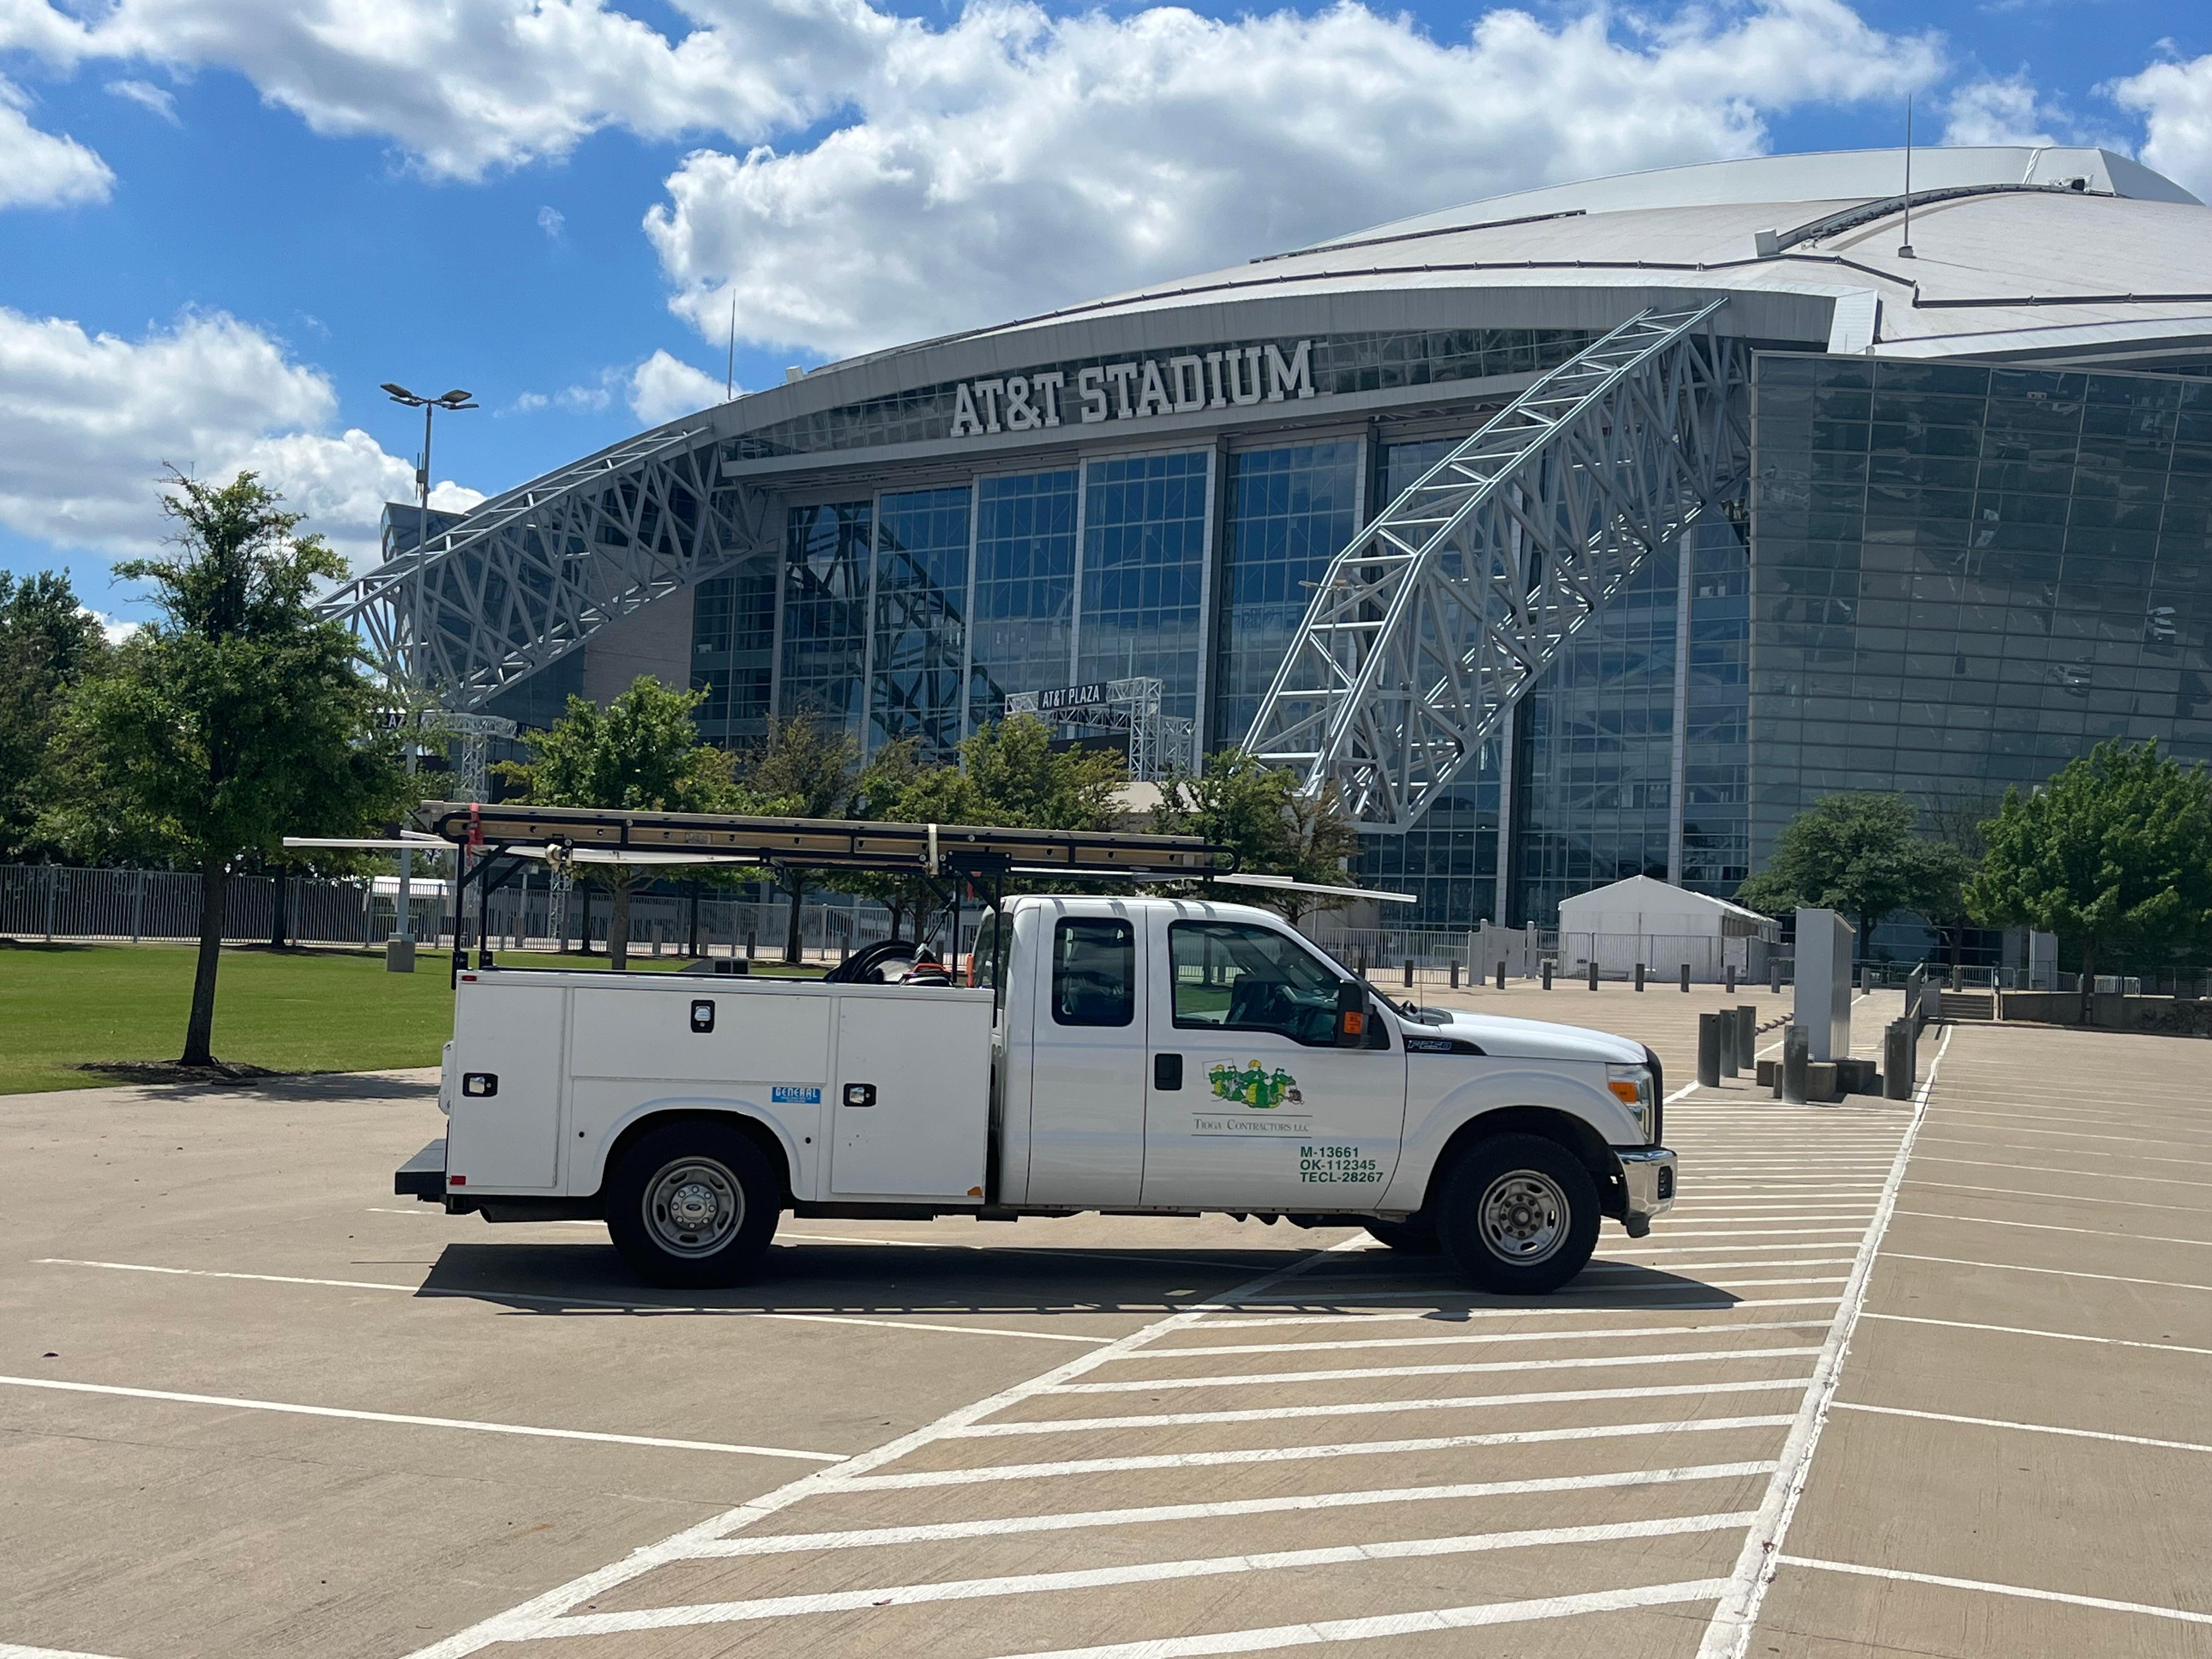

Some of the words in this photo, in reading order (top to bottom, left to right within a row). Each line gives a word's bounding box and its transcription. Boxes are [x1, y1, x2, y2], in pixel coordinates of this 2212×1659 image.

[950, 371, 1064, 437] AT&T
[1078, 340, 1315, 423] STADIUM
[1042, 690, 1066, 708] AT&T
[1069, 685, 1099, 705] PLAZA
[1300, 1146, 1358, 1158] M-13661
[1300, 1159, 1376, 1170] OK-112345
[1300, 1172, 1384, 1182] TECL-28267
